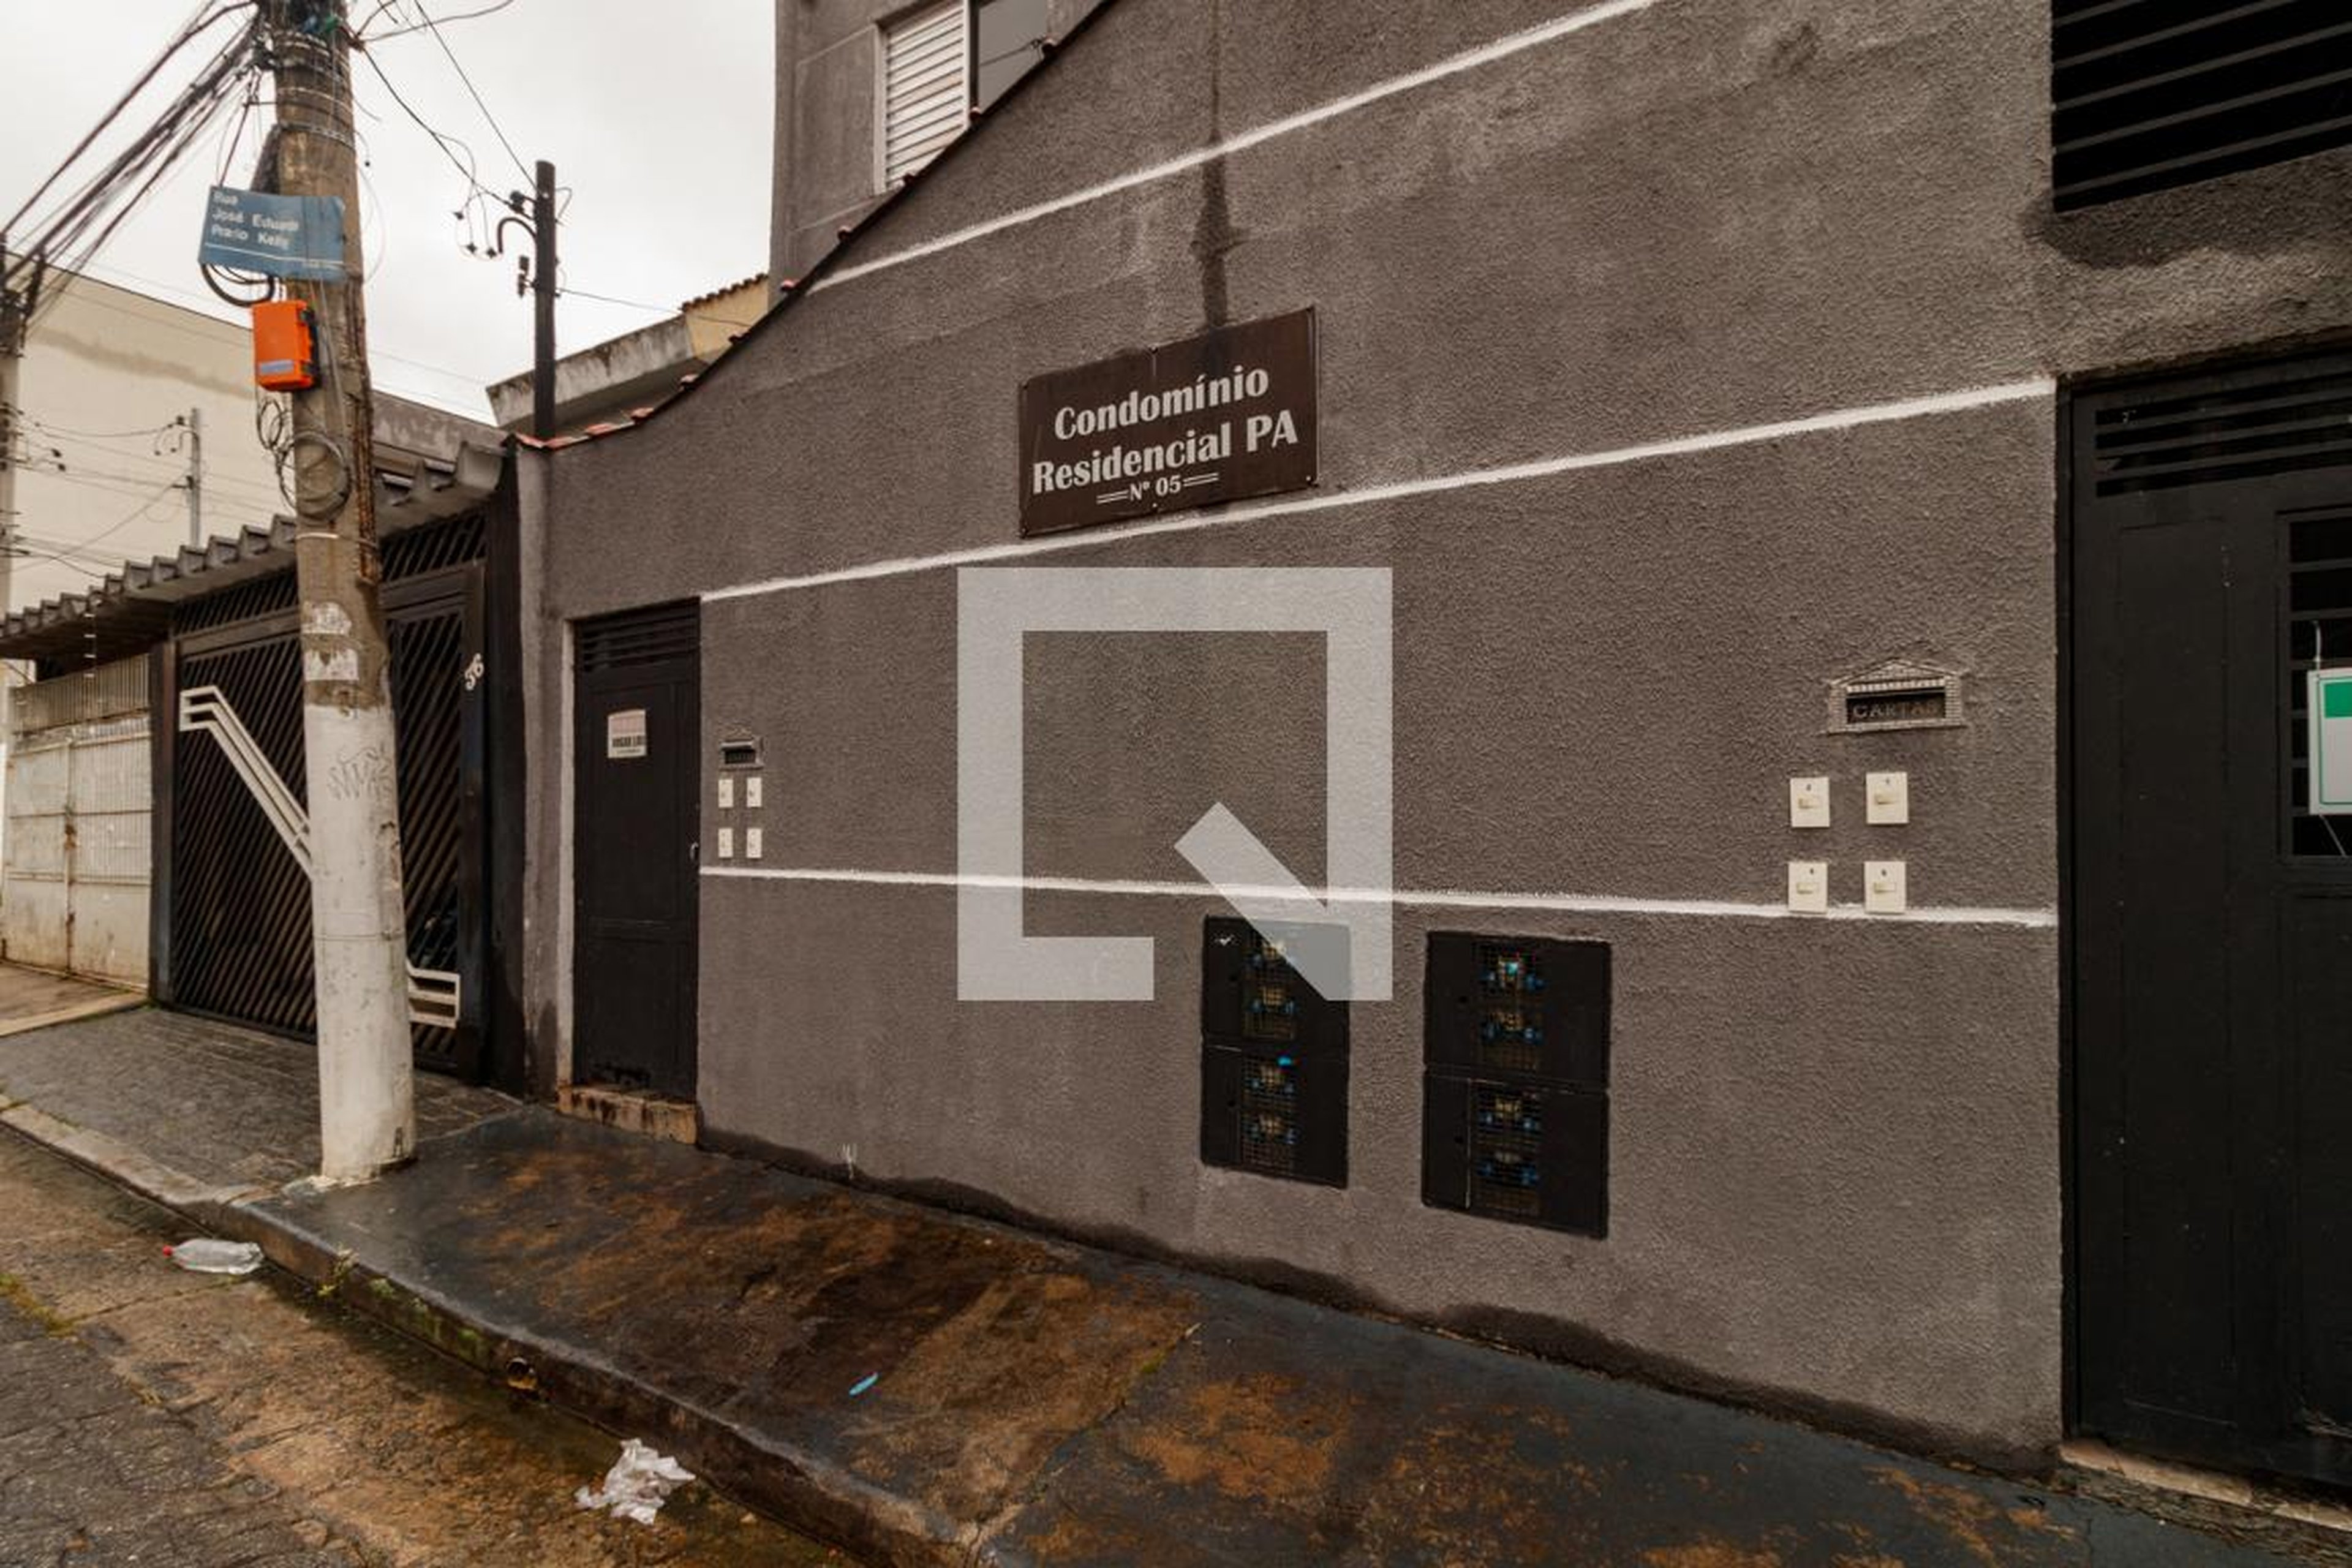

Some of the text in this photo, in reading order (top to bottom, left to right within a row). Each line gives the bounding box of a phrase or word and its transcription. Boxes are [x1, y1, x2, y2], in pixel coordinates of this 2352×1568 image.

[213, 191, 238, 205] Rua
[1055, 366, 1269, 440] Condomínio
[1033, 409, 1299, 494] Residencial PA
[1155, 475, 1182, 497] 05
[464, 653, 484, 691] 56
